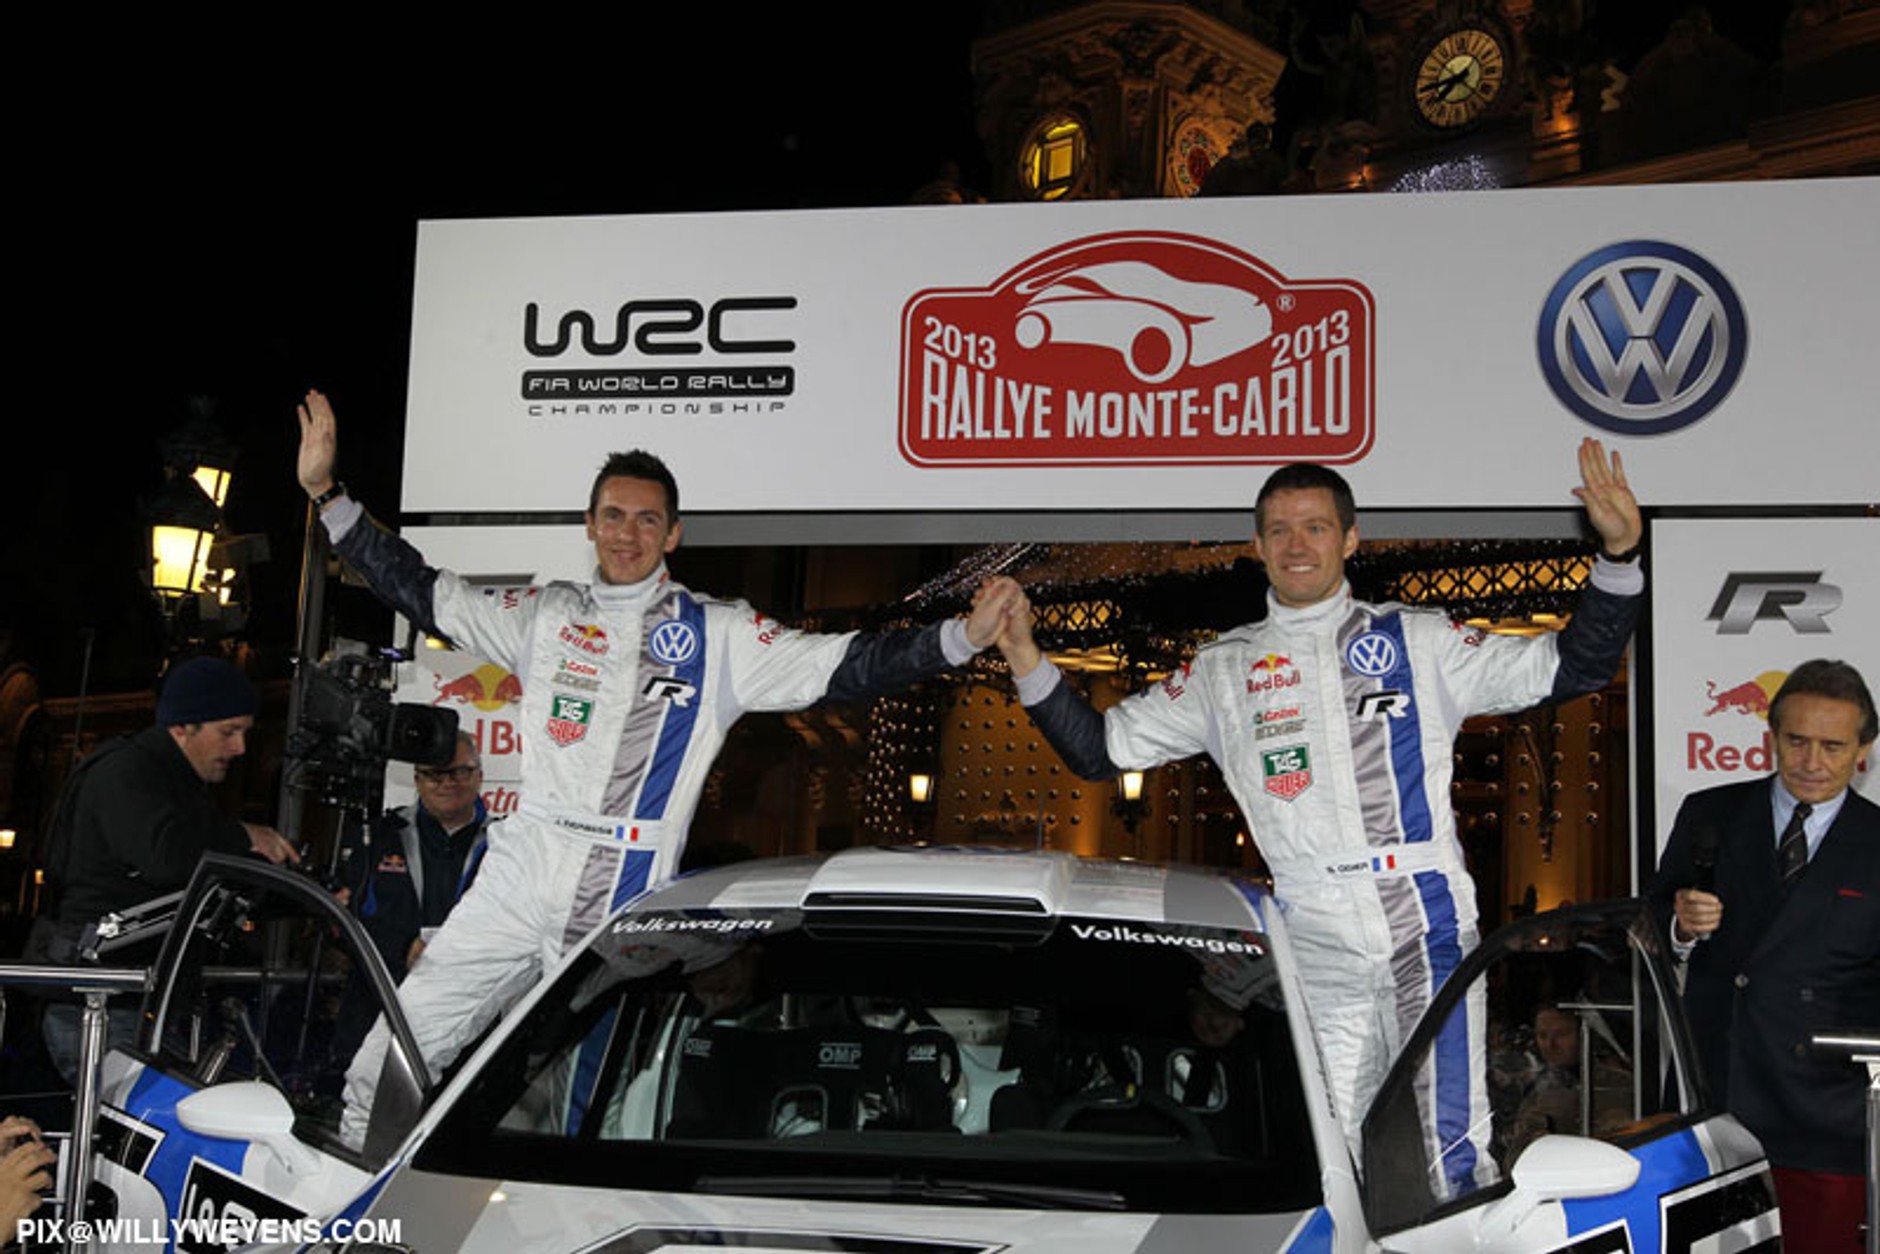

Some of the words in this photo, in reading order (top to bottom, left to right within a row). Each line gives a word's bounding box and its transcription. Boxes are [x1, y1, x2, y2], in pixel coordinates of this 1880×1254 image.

[524, 296, 798, 357] WRC
[1271, 309, 1350, 369] 2013
[924, 315, 997, 370] 2013
[528, 377, 570, 392] FIA
[578, 375, 679, 392] WORLD
[687, 373, 787, 390] RALLY
[921, 348, 1052, 440] RALLYE
[1066, 345, 1351, 438] MONTE-CARLO
[528, 401, 787, 416] CHAMPIONSHIP
[1246, 674, 1273, 695] Red
[1273, 670, 1301, 688] Bull
[1267, 751, 1303, 775] TAG
[1687, 731, 1774, 771] Red
[612, 918, 774, 933] Volkswagen
[1071, 925, 1265, 955] Volkswagen
[818, 1049, 862, 1063] OMP
